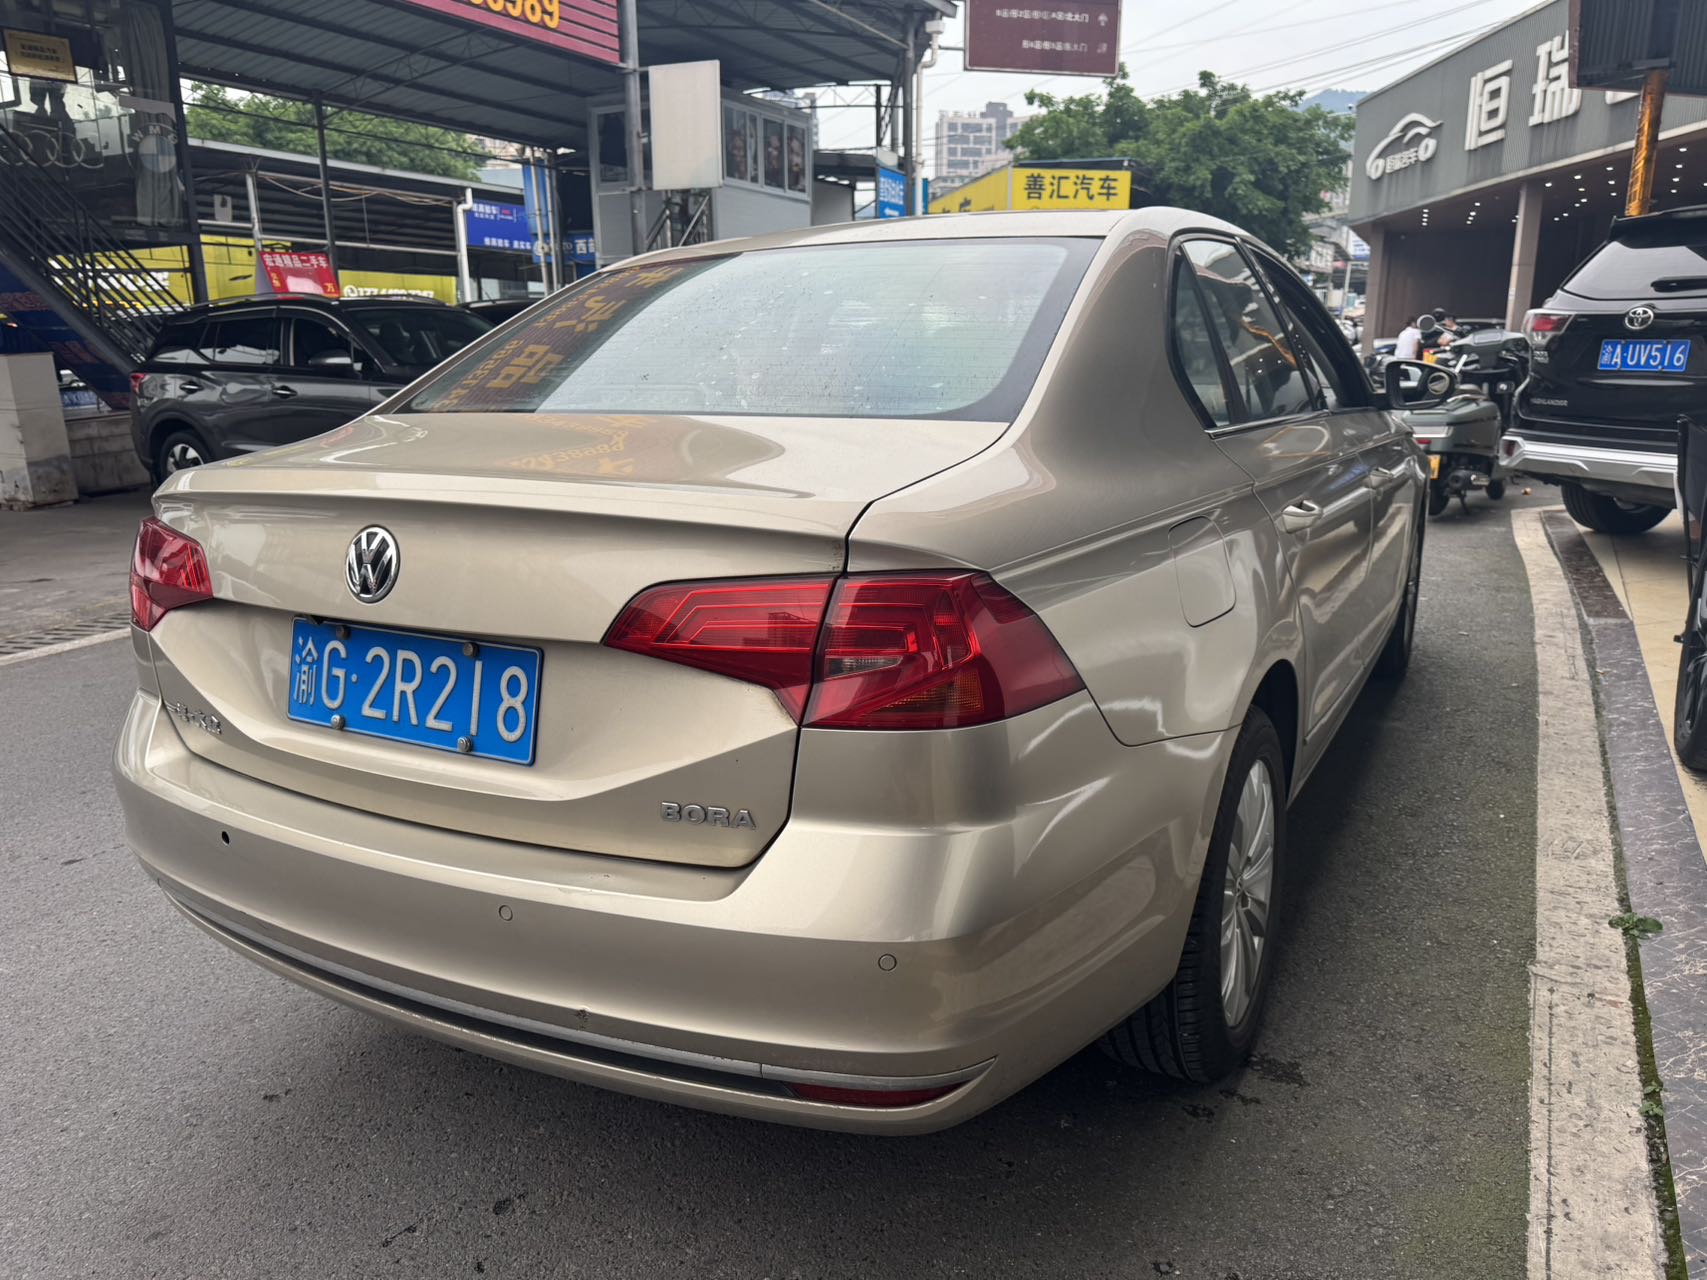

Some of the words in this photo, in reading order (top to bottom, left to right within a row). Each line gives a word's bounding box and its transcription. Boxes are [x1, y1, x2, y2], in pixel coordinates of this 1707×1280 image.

[1023, 173, 1119, 201] 善汇汽车
[293, 636, 529, 743] 渝G·2R218
[661, 801, 757, 830] BORA
